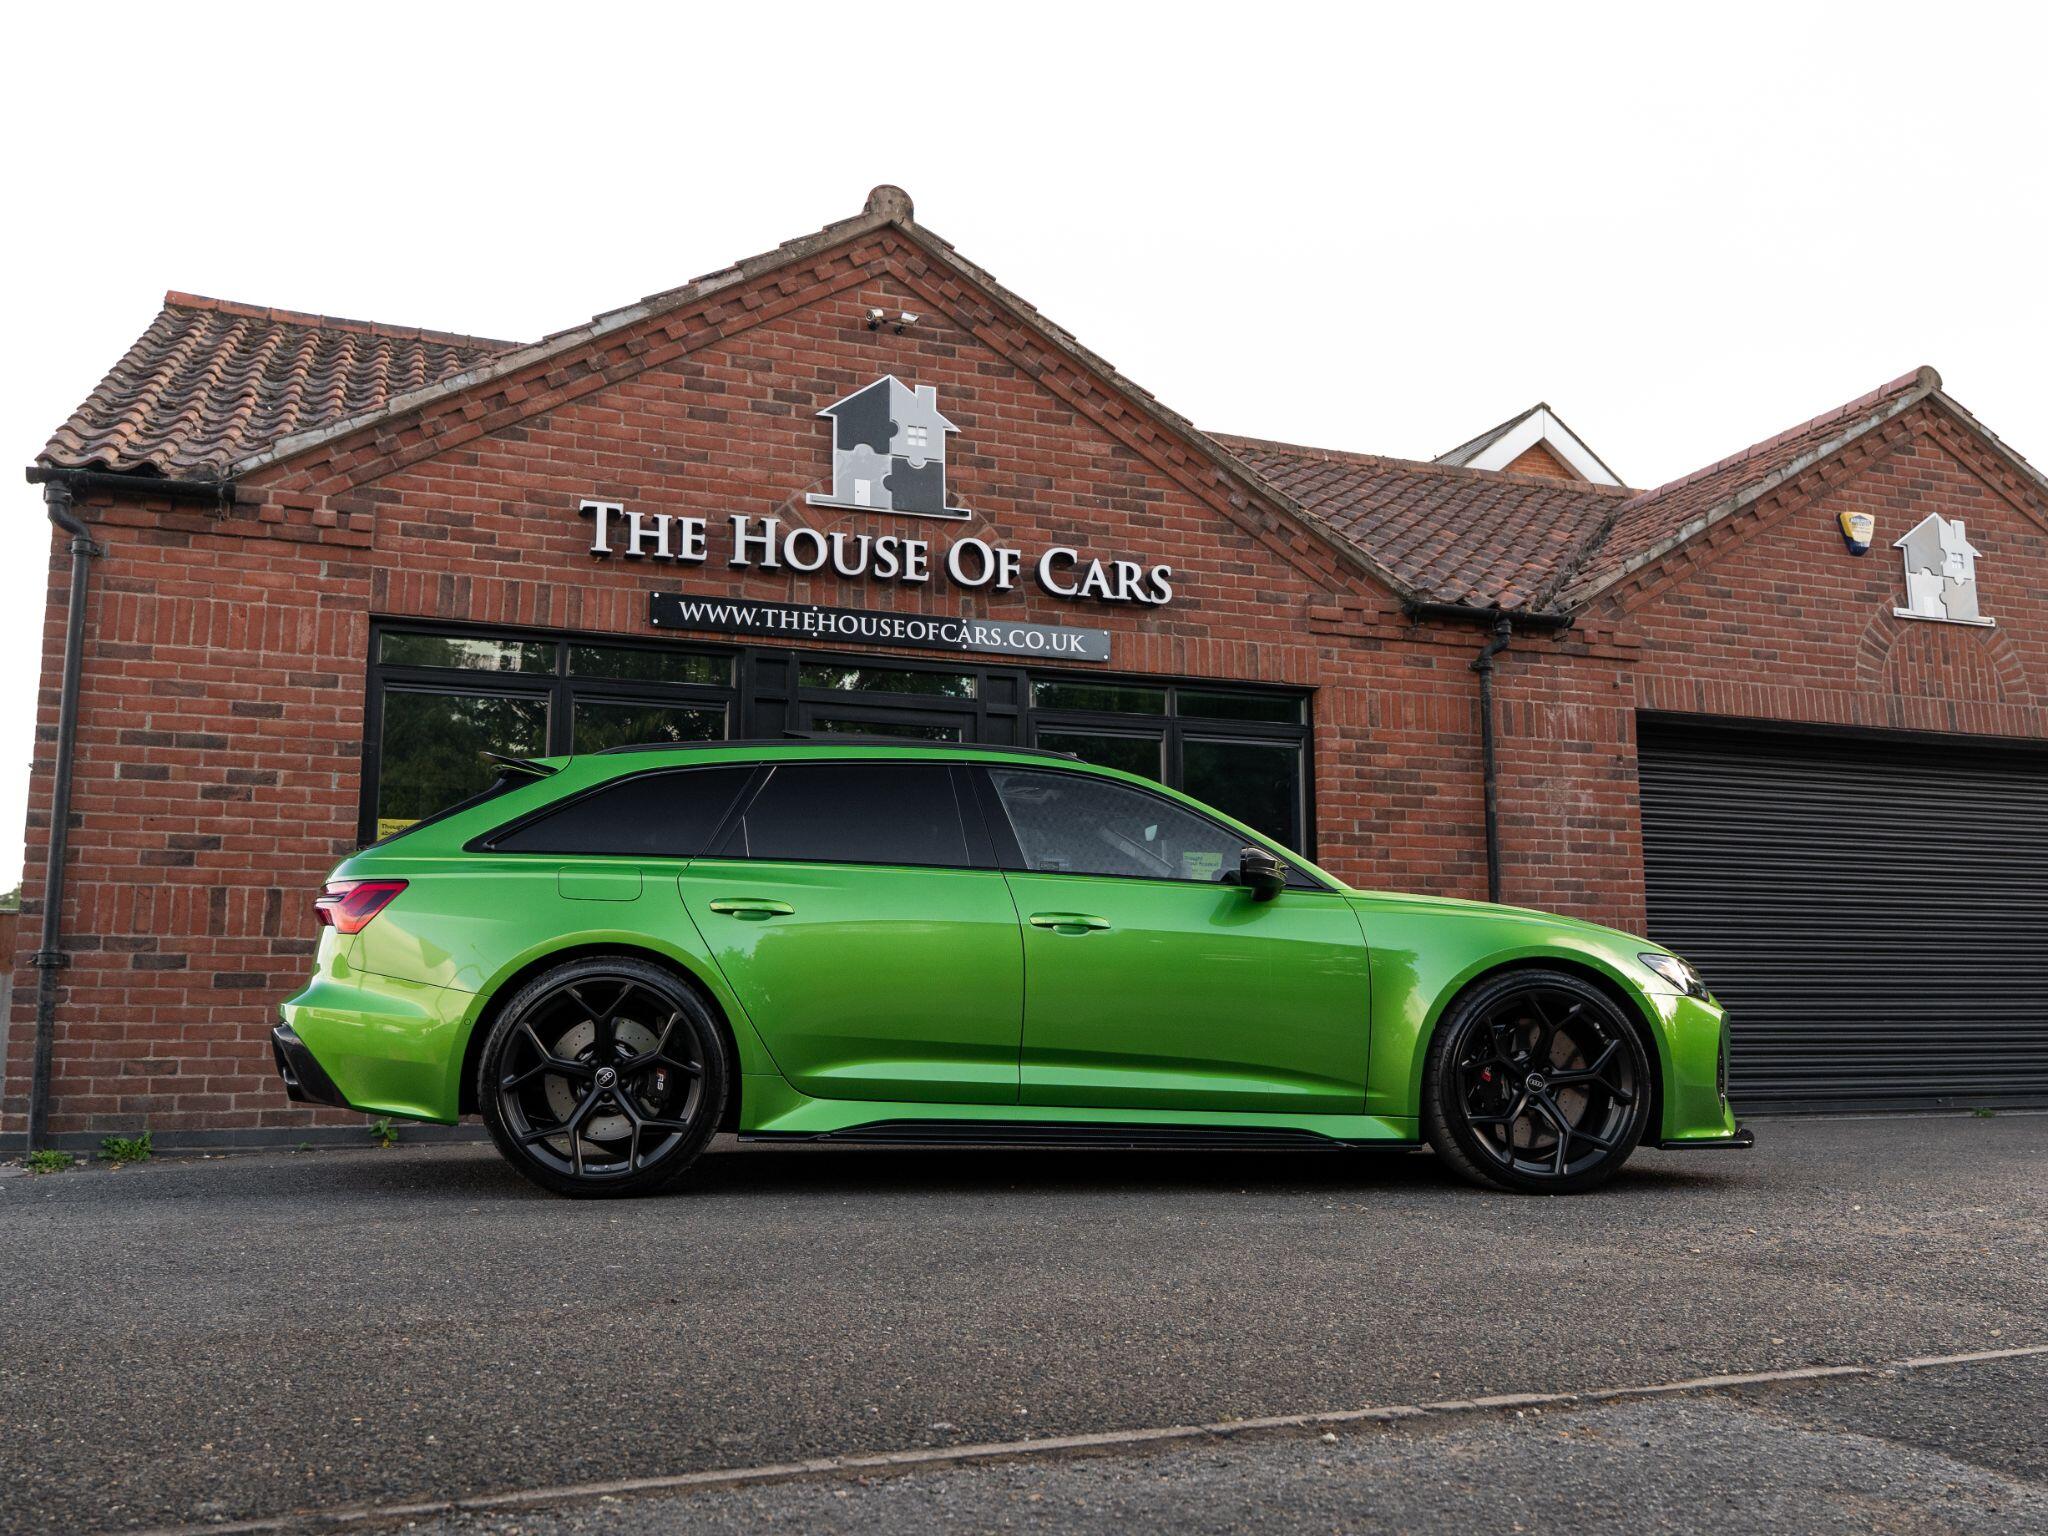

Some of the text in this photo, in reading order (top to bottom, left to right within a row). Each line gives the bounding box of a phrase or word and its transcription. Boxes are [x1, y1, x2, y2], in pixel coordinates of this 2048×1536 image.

[579, 499, 708, 561] THE
[729, 514, 930, 582] HOUSE
[1038, 547, 1174, 605] CARS
[678, 600, 1087, 653] WWW.THEHOUSEOFCARS.CO.UK
